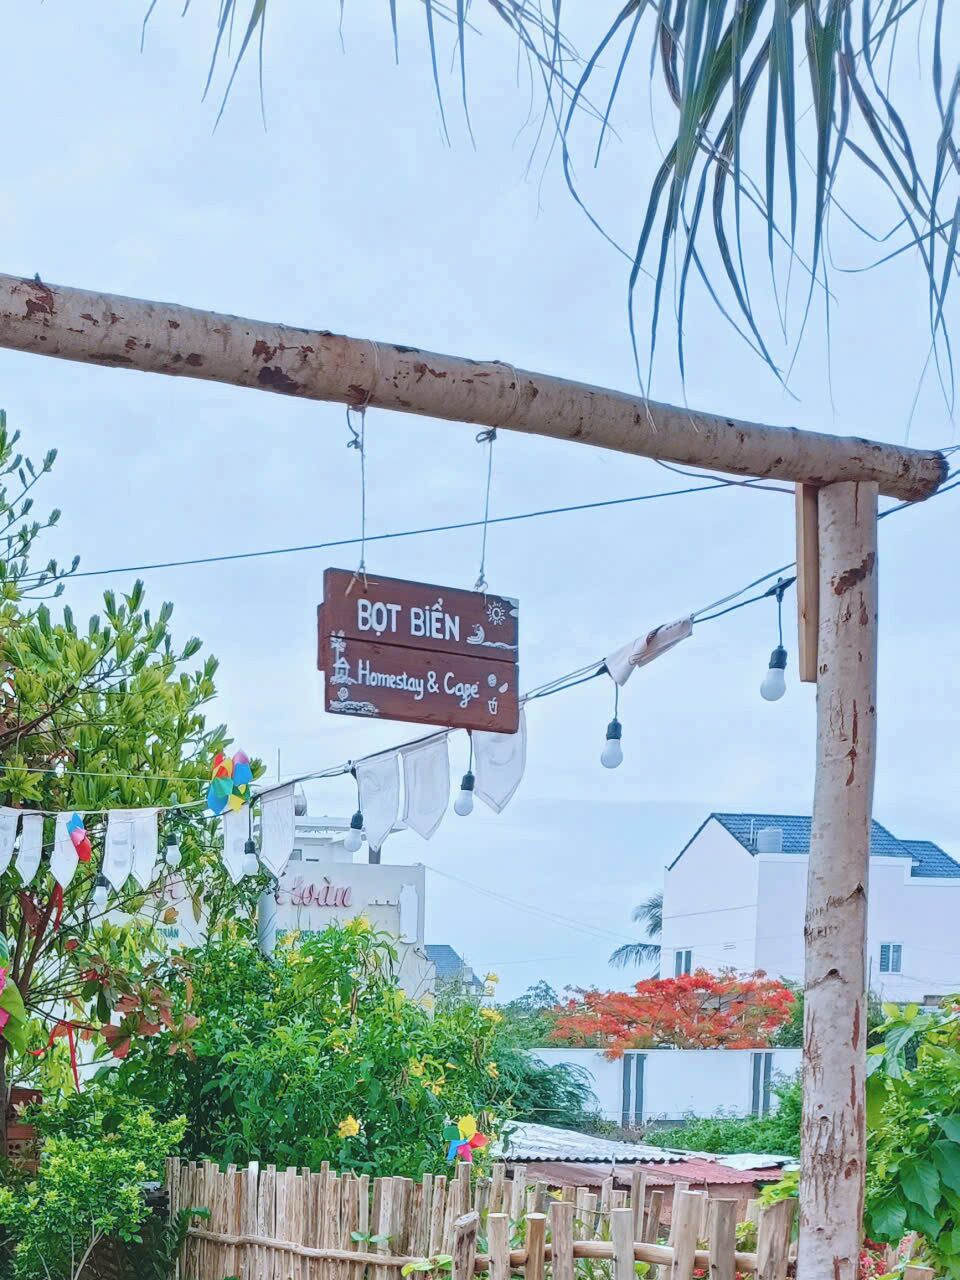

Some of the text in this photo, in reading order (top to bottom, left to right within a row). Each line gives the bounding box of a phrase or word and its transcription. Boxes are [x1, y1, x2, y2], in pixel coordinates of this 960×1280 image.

[357, 598, 402, 636] BỌT
[358, 658, 424, 700] Homestay
[426, 670, 440, 693] &
